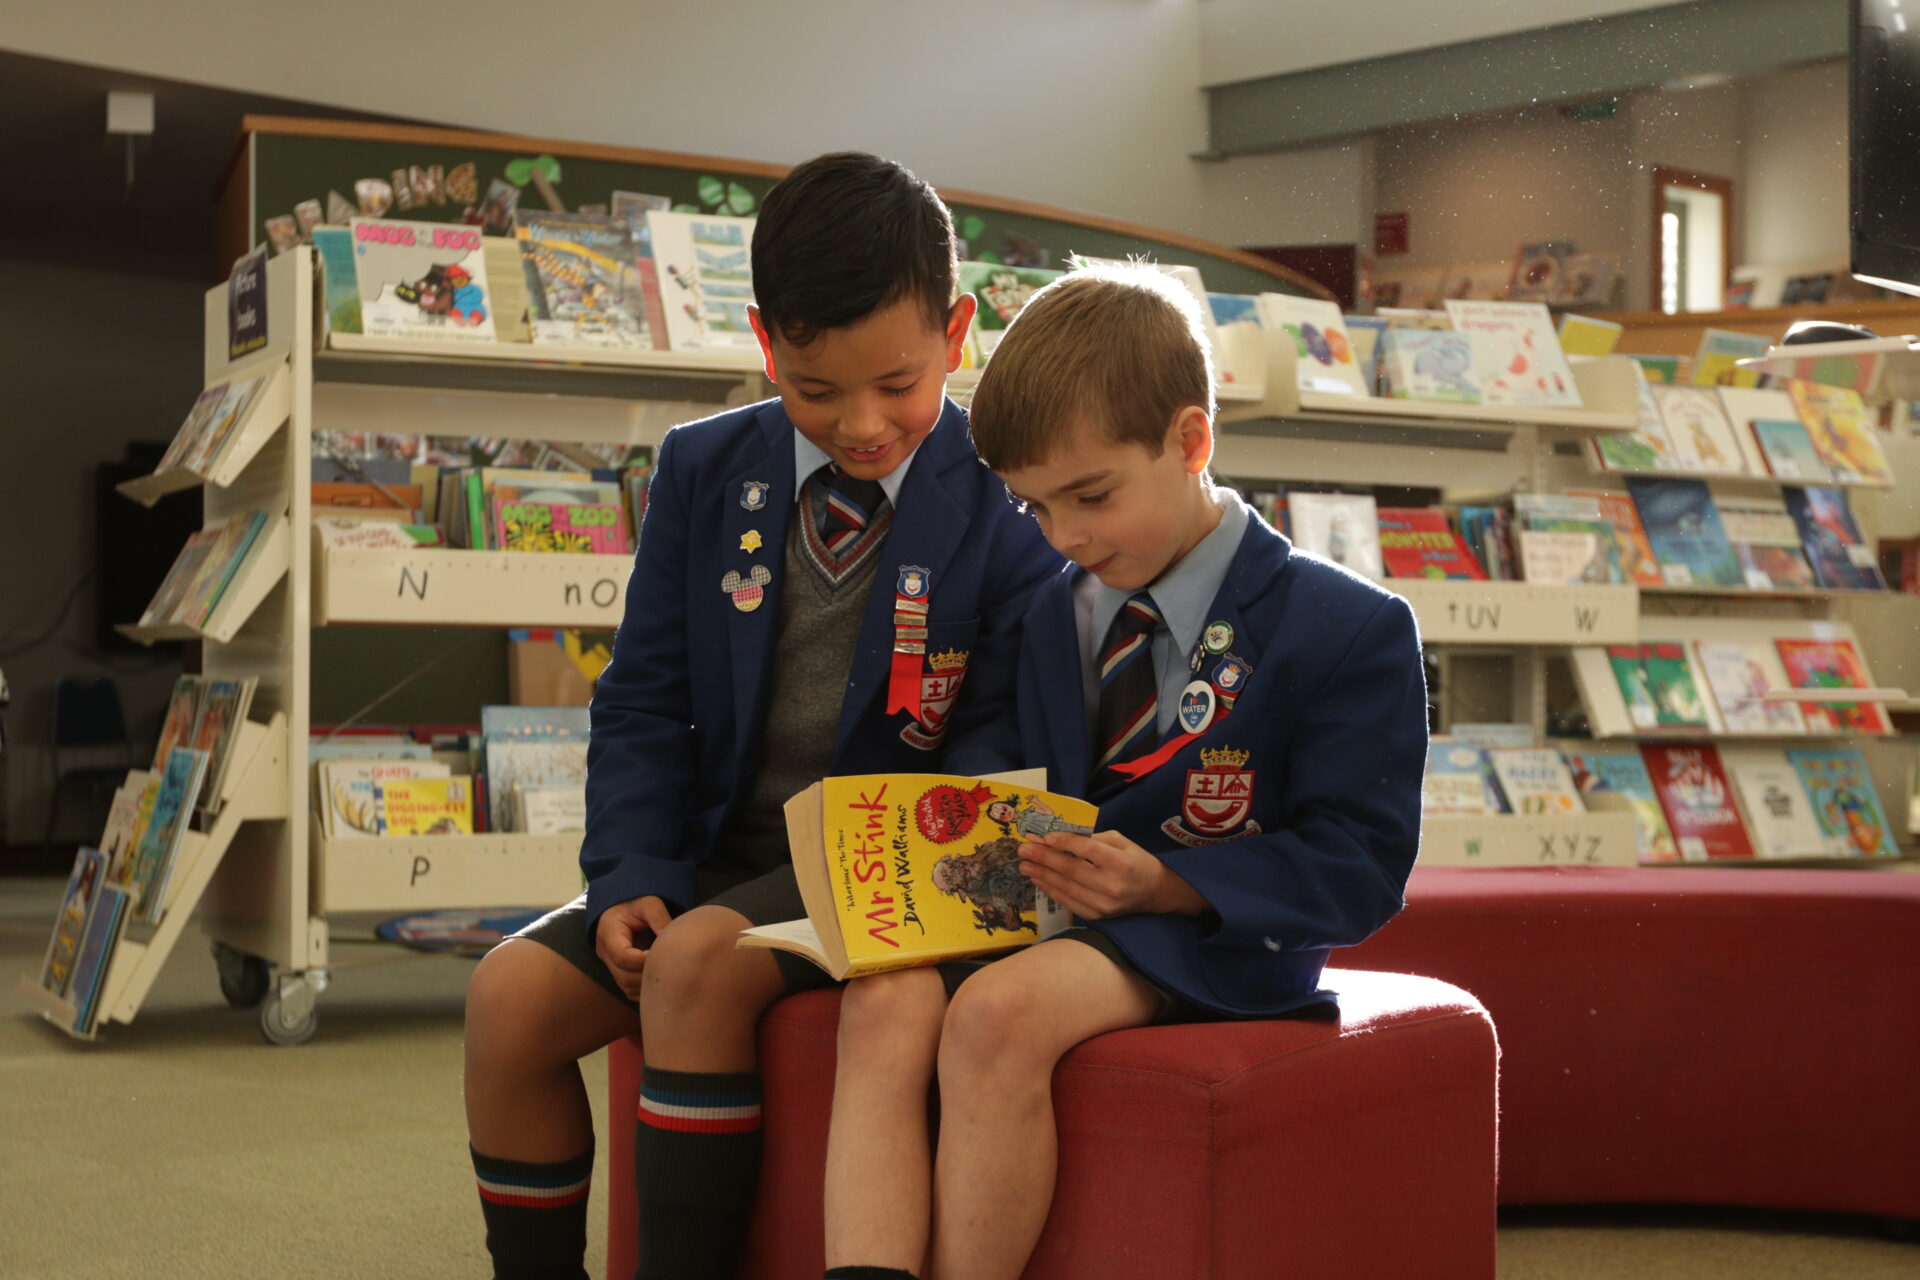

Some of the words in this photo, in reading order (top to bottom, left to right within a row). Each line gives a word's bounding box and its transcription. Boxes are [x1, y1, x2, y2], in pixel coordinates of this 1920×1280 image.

[355, 223, 416, 247] MOG
[433, 228, 480, 250] FOG
[501, 504, 552, 525] MOG
[568, 507, 617, 527] ZOO
[1379, 530, 1455, 549] MONSTER
[398, 566, 427, 600] N
[1573, 606, 1599, 632] W
[1182, 704, 1207, 714] WATER
[848, 782, 888, 883] Stink
[893, 804, 911, 878] Walliams
[411, 856, 430, 888] P
[865, 890, 900, 948] Mr
[896, 879, 924, 935] David
